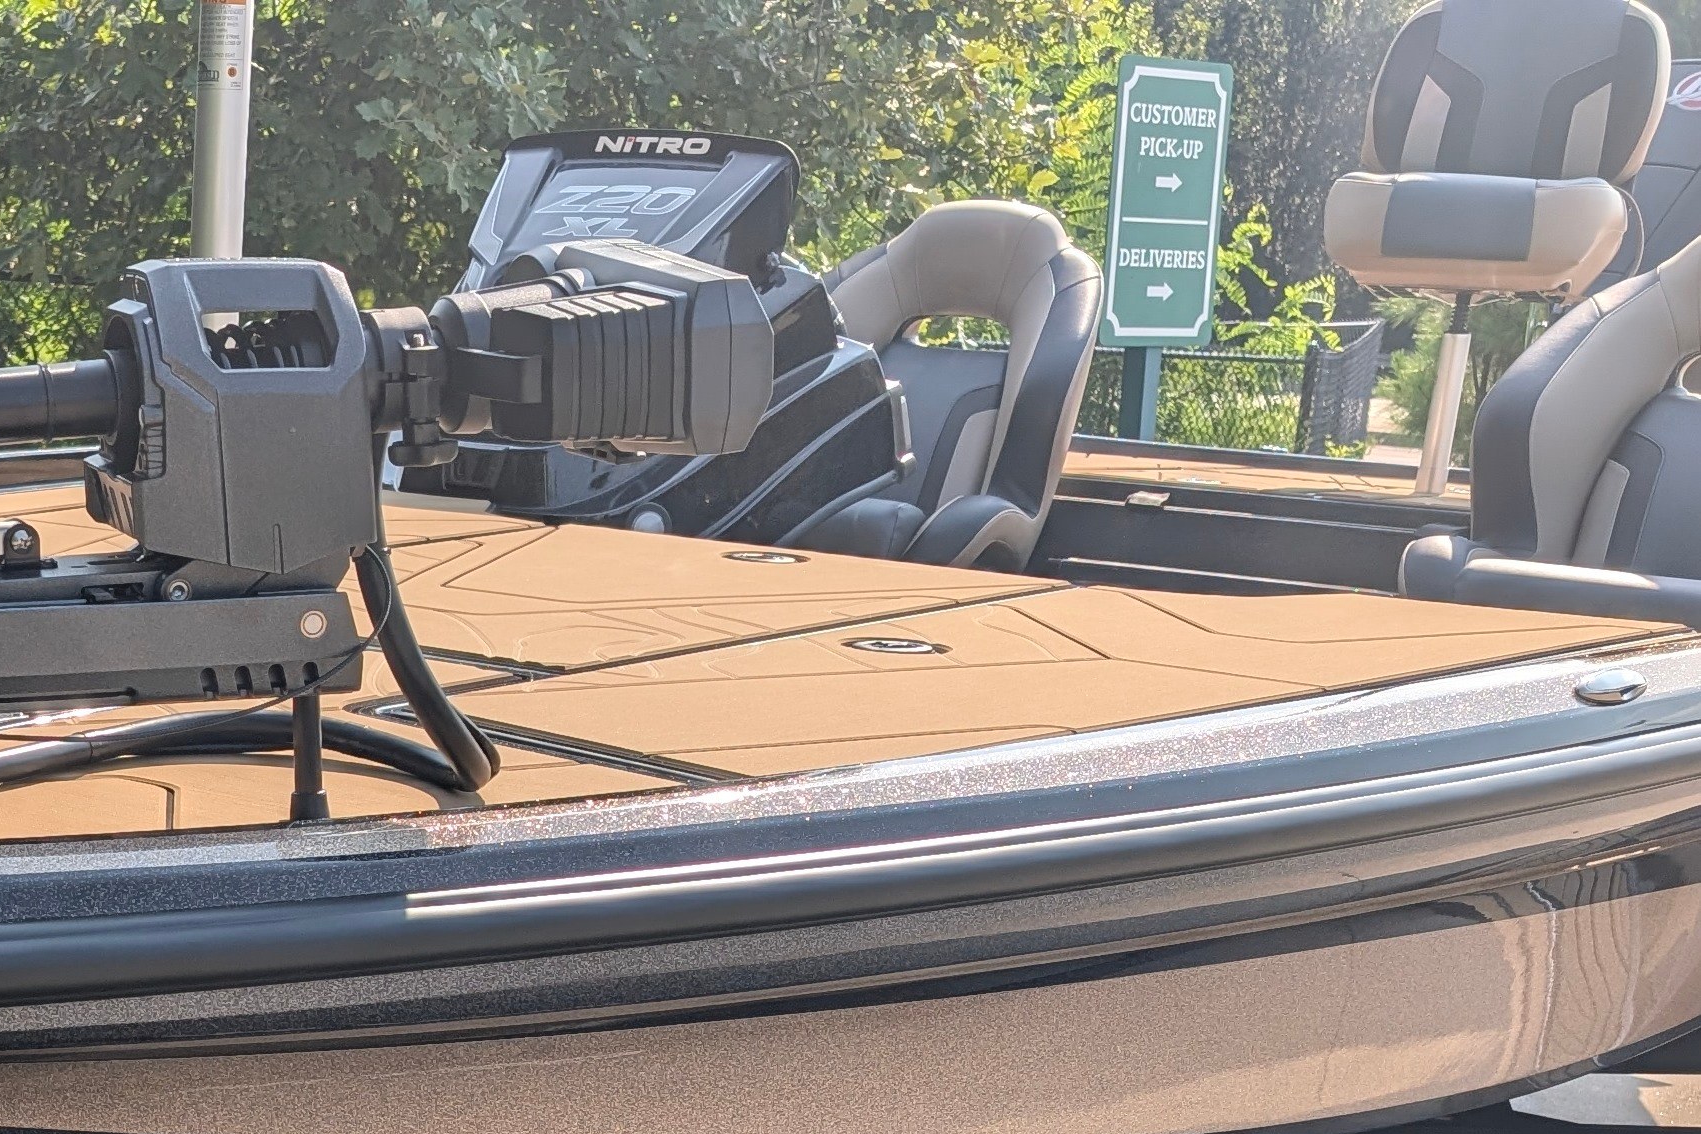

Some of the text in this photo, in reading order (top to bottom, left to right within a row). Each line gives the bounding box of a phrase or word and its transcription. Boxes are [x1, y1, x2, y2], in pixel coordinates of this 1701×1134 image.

[1130, 102, 1217, 128] CUSTOMER
[1139, 136, 1204, 159] PICK-UP
[534, 184, 697, 215] Z20
[541, 216, 639, 238] XL
[1119, 248, 1206, 270] DELIVERIES
